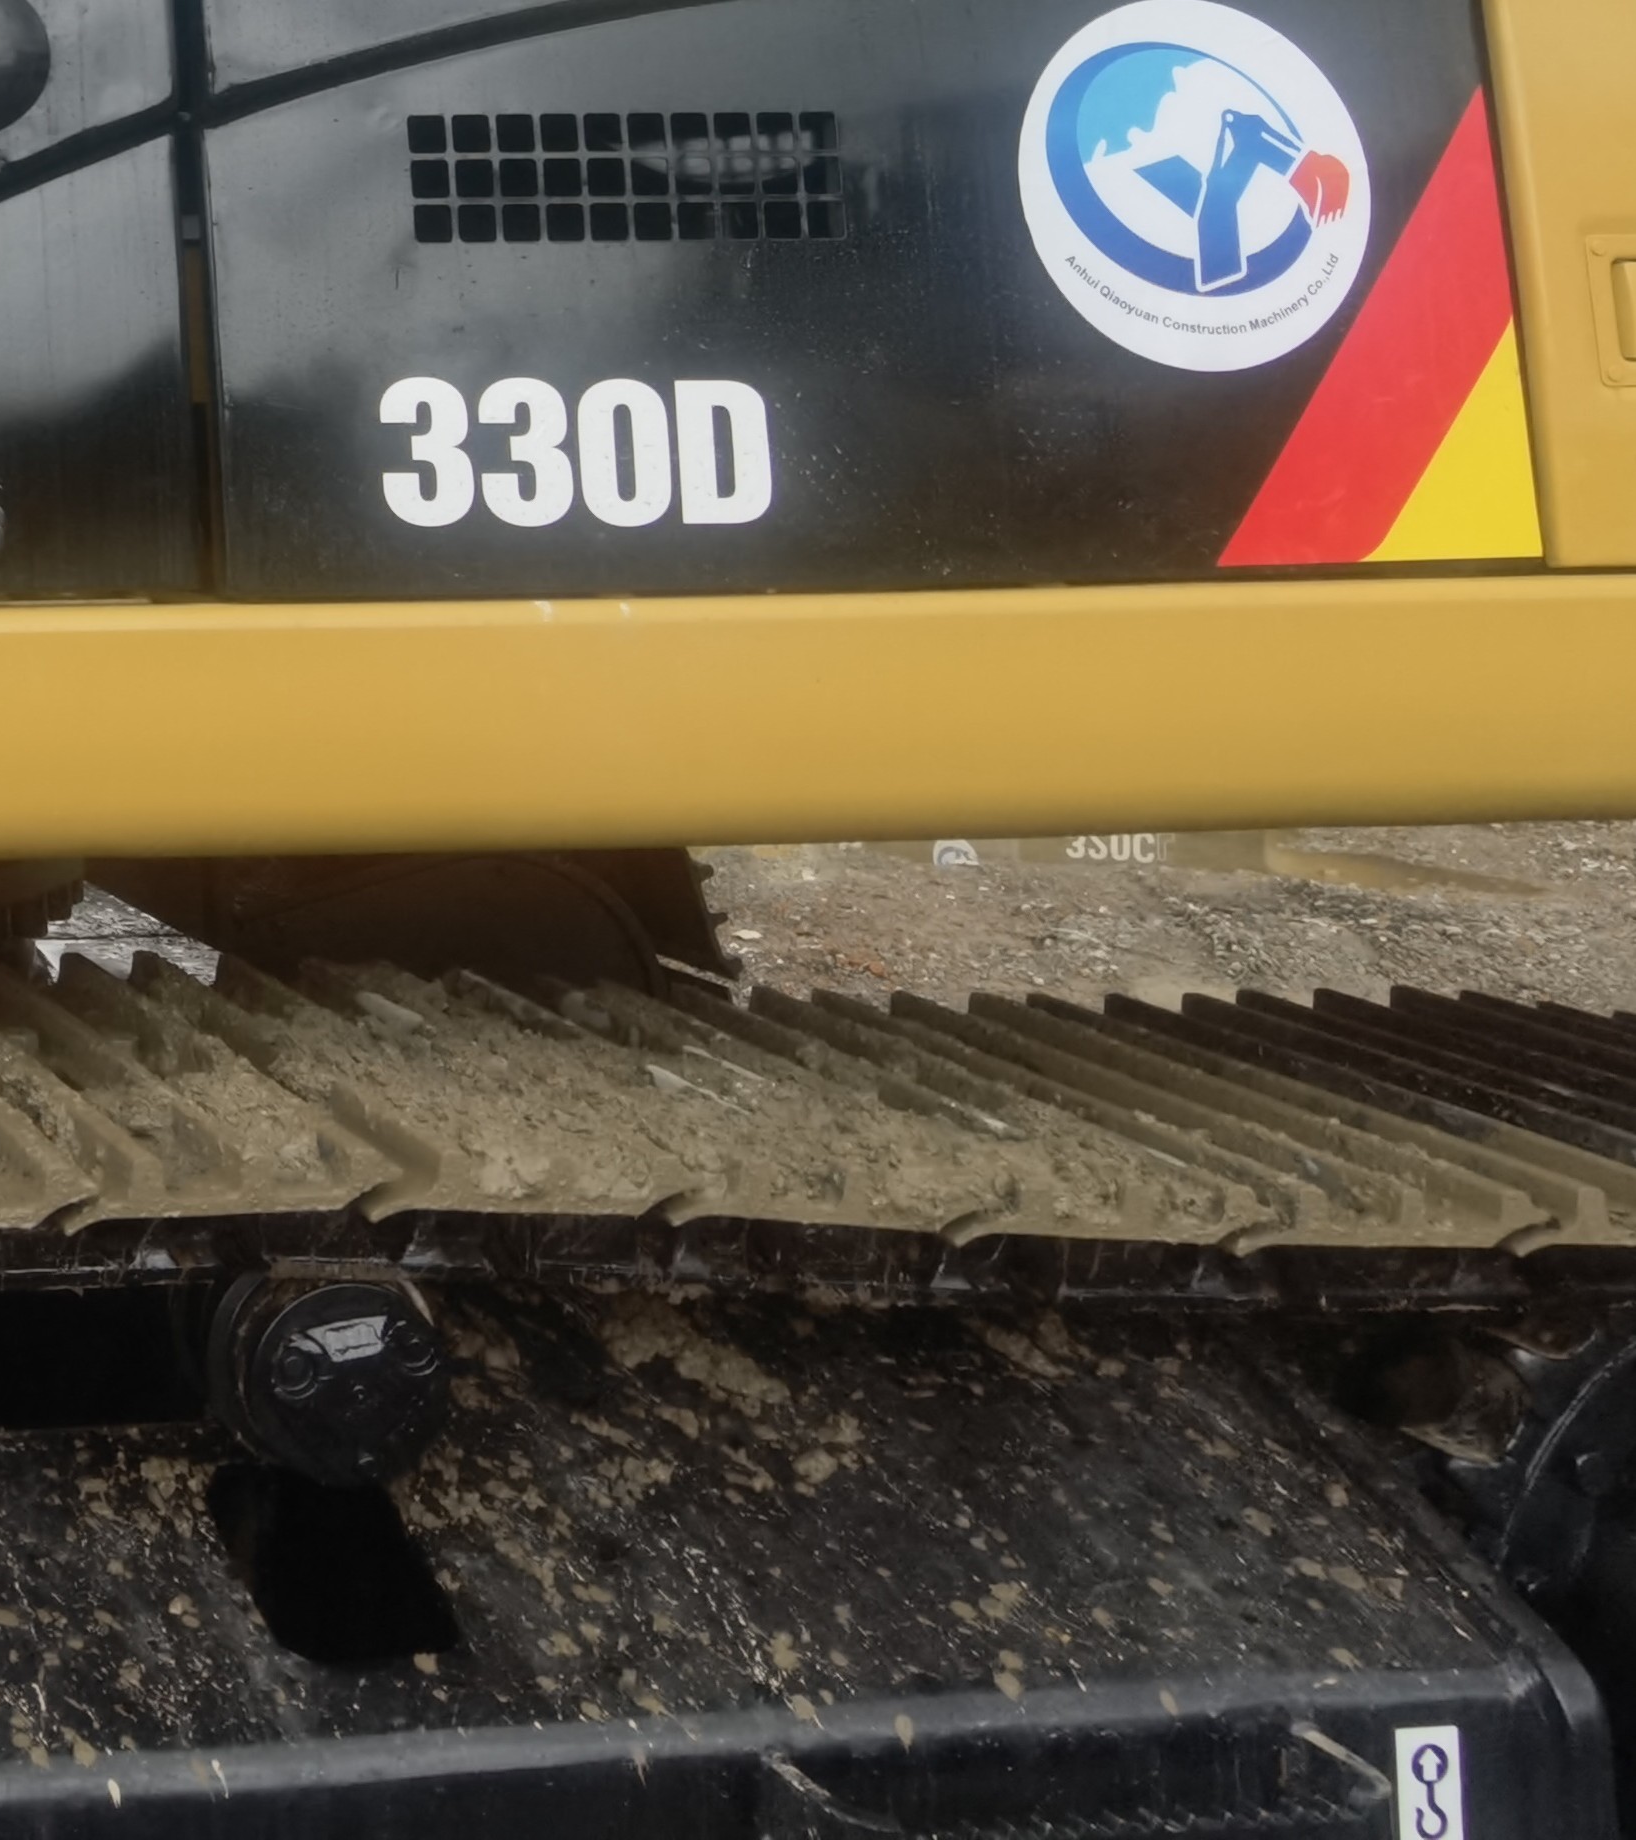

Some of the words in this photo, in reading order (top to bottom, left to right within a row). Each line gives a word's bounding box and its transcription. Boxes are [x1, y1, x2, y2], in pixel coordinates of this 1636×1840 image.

[1065, 254, 1100, 290] Anhui
[1098, 284, 1159, 325] Qiaoyuan
[1162, 316, 1248, 336] Construction
[1250, 293, 1311, 331] Machinery
[378, 376, 774, 528] 330D
